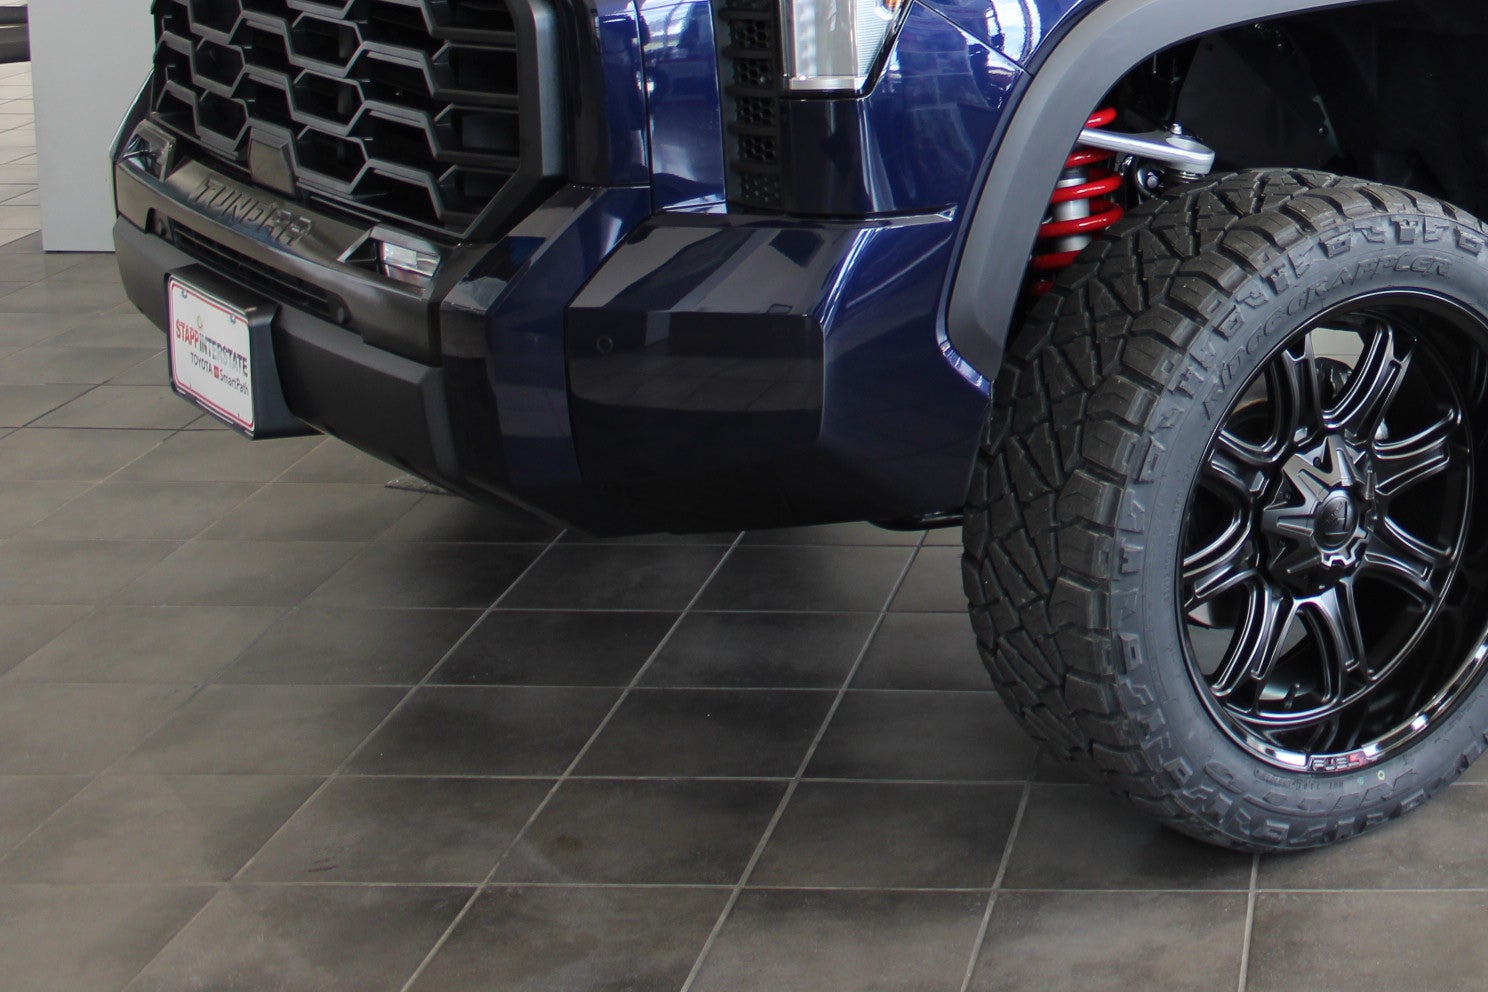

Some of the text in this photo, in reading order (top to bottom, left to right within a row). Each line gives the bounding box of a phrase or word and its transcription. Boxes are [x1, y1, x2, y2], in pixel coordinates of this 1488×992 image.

[187, 176, 313, 248] TUNDRA
[175, 318, 249, 378] STAPP INTERSTATE
[189, 351, 250, 396] TOYOTA SmartPath
